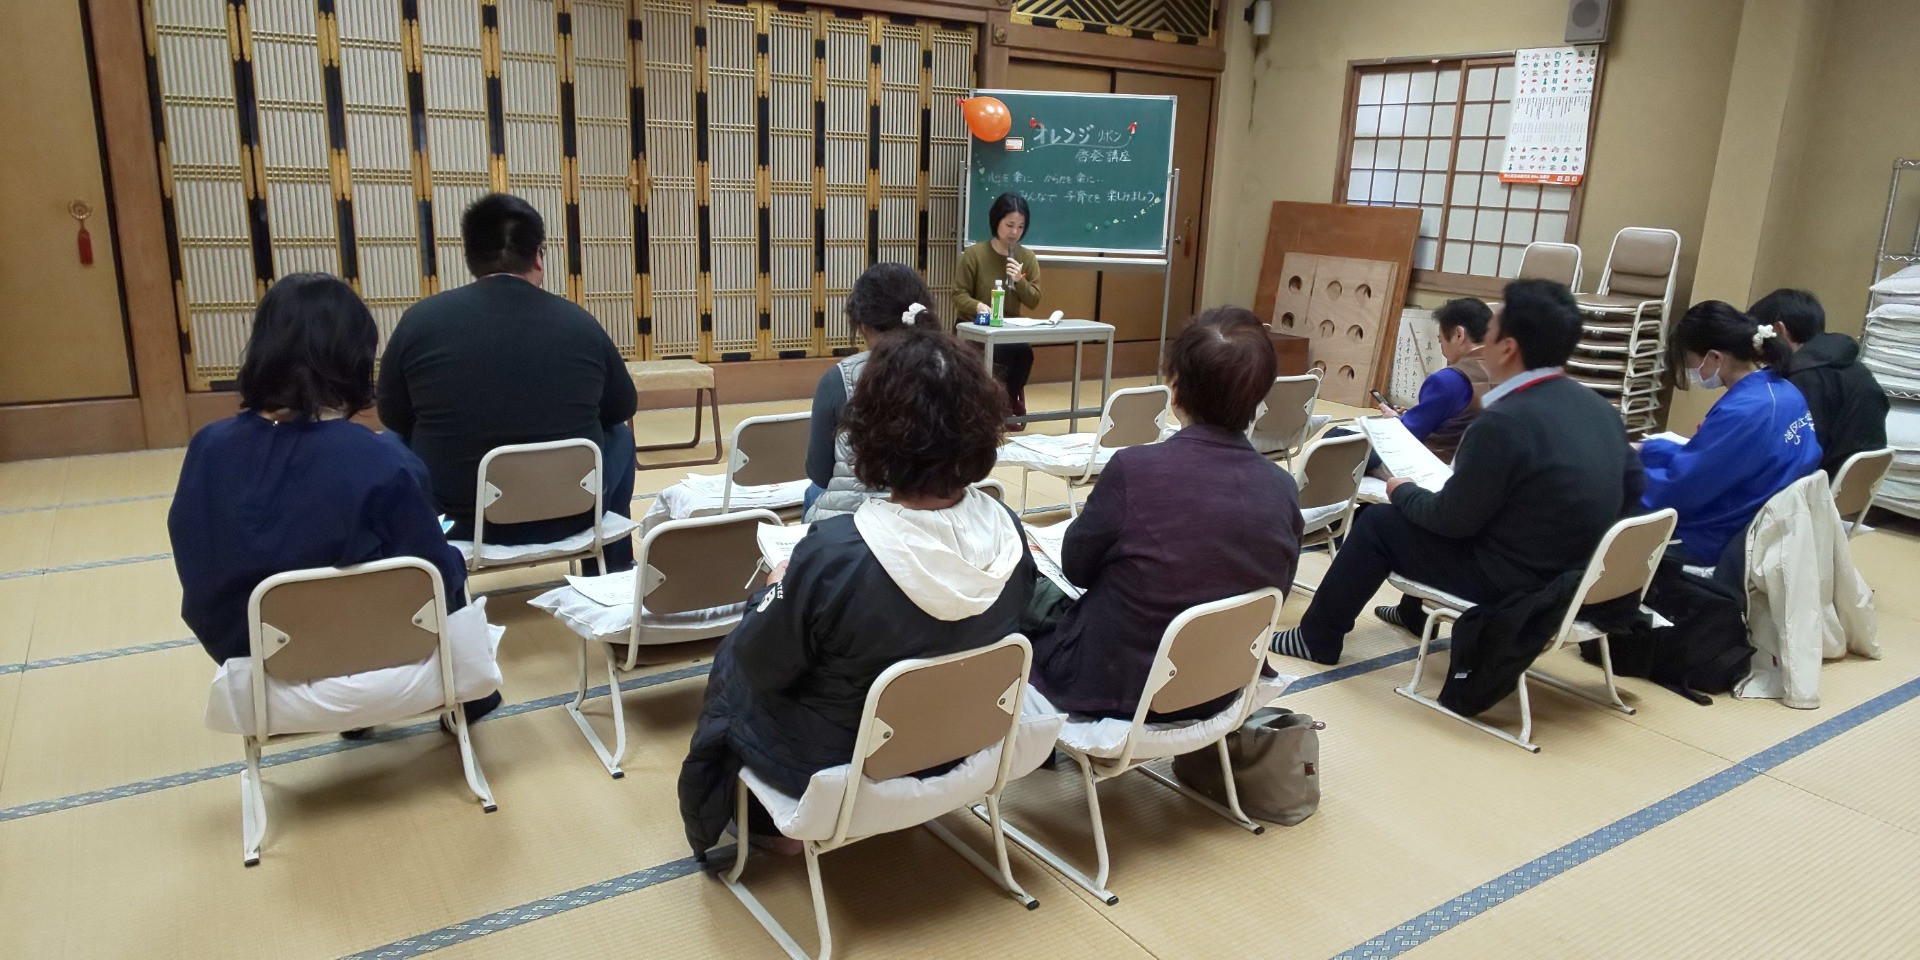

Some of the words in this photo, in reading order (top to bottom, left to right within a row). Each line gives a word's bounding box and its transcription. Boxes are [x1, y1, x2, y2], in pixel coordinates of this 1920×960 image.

[1033, 124, 1095, 144] オレンジ
[1098, 129, 1122, 143] リボン
[1064, 189, 1101, 204] 子育てを
[1106, 189, 1156, 203] 楽しみましょう
